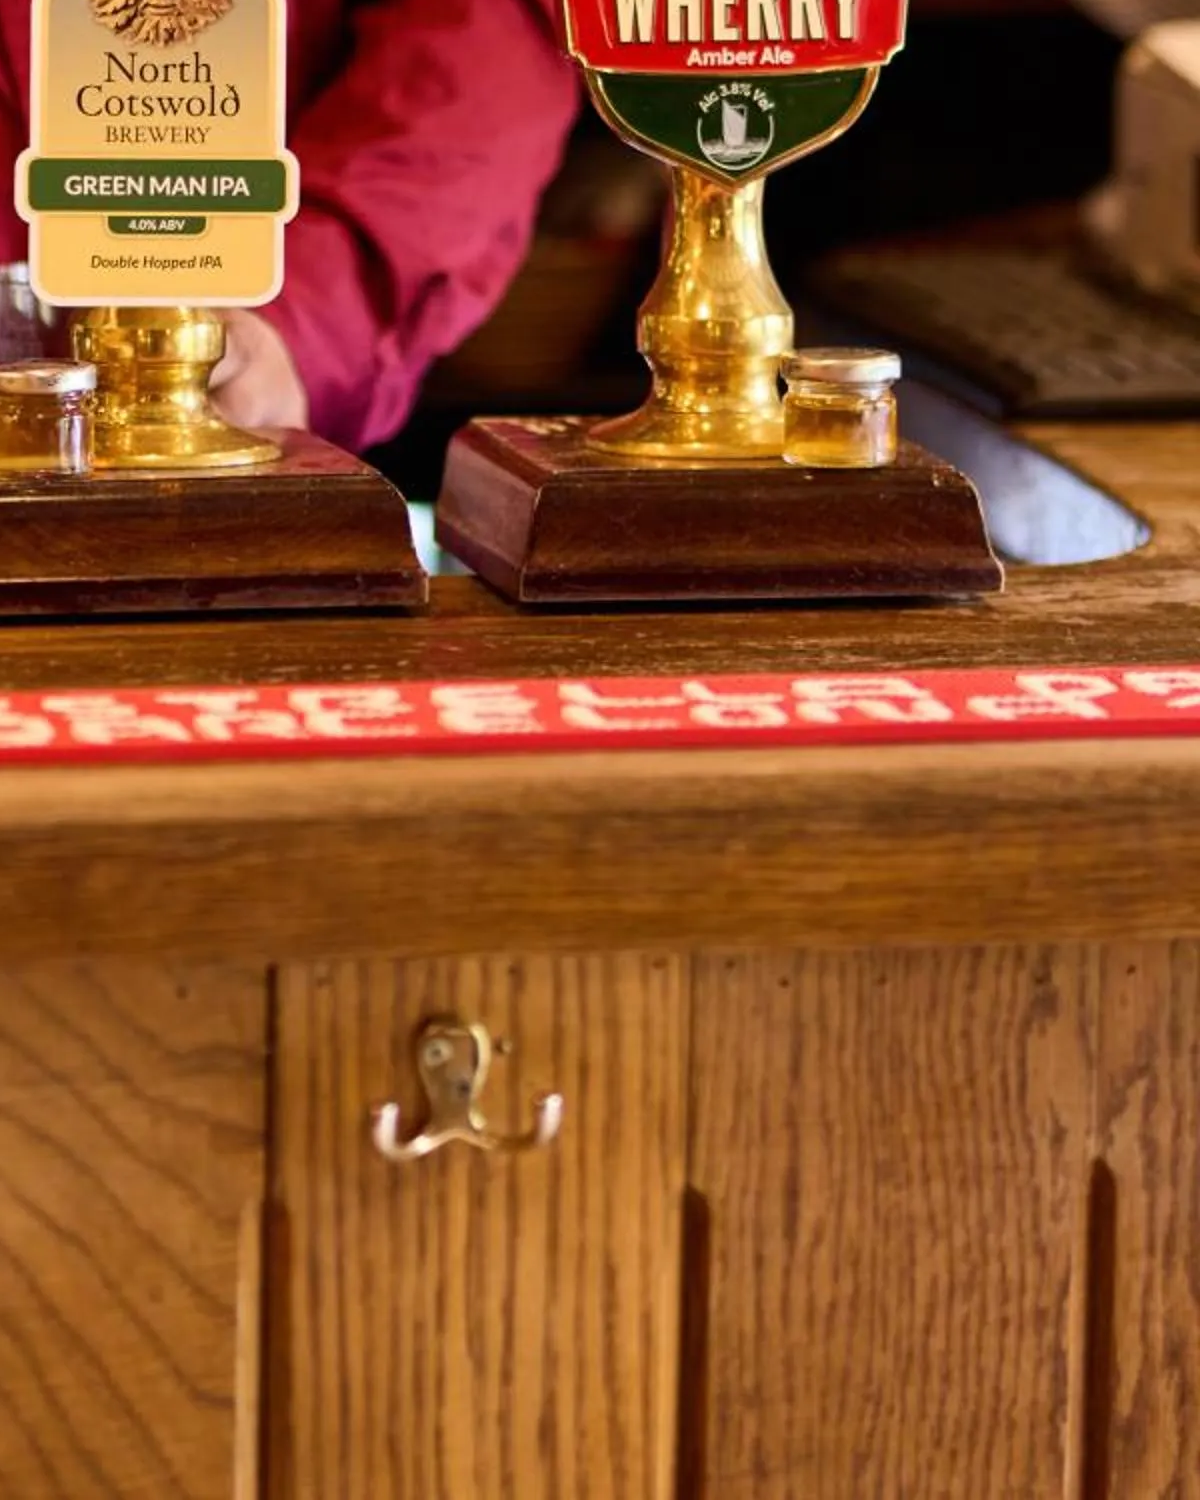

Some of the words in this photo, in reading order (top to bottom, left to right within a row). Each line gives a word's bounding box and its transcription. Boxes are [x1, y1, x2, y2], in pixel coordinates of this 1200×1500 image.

[103, 51, 213, 84] North
[687, 48, 756, 67] Amber
[759, 48, 795, 65] Ale
[76, 84, 241, 119] Cotswold
[699, 90, 720, 114] Alc
[719, 81, 752, 97] 3.8%
[752, 87, 775, 113] Vol
[104, 124, 211, 145] BREWERY
[64, 175, 145, 196] GREEN
[149, 175, 207, 197] MAN
[211, 176, 251, 197] IPA
[128, 219, 157, 231] 4.0%
[159, 219, 186, 231] ABV
[90, 254, 140, 269] Double
[142, 255, 197, 271] Hopped
[199, 255, 223, 269] IPA
